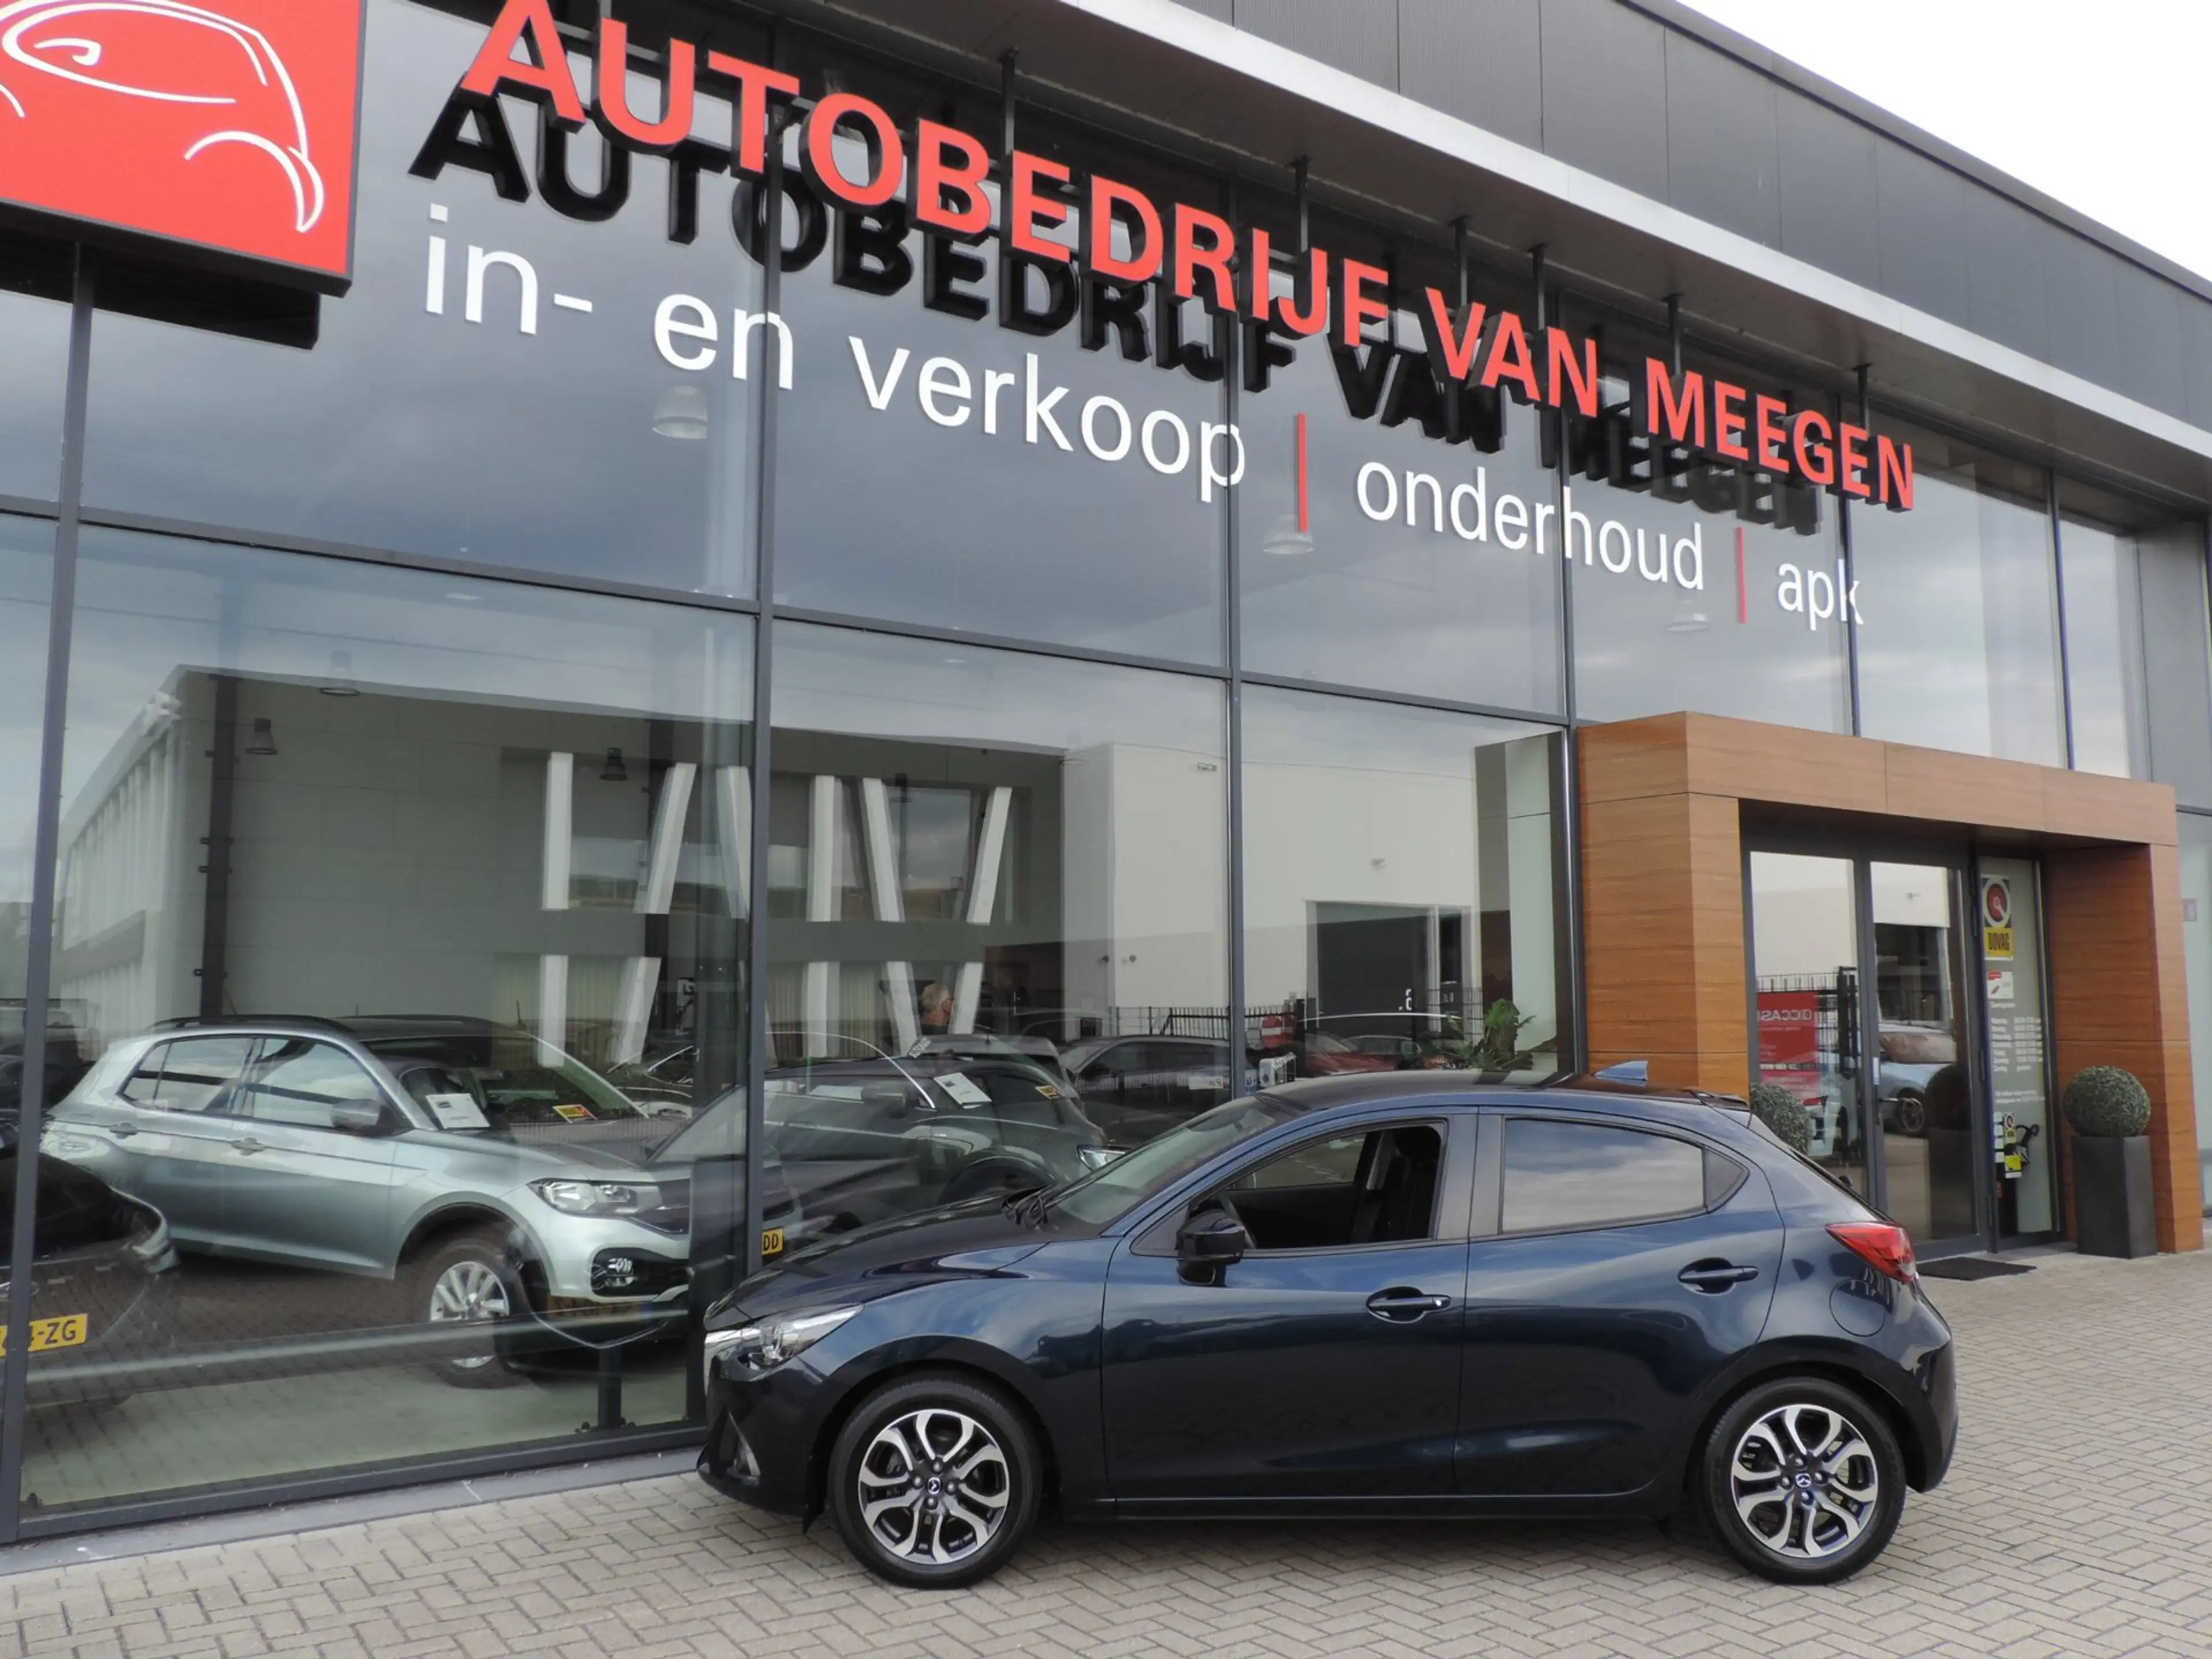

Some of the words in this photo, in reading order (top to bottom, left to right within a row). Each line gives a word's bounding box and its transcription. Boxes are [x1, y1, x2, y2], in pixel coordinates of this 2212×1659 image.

[425, 203, 593, 335] in-
[654, 294, 794, 390] en
[849, 336, 1246, 503] verkoop
[1357, 462, 1703, 590] onderhoud
[1778, 558, 1865, 631] apk
[460, 0, 1389, 380] AUTOBEDRIJF
[1426, 287, 1599, 418] VAN
[1646, 357, 1914, 509] MEEGEN
